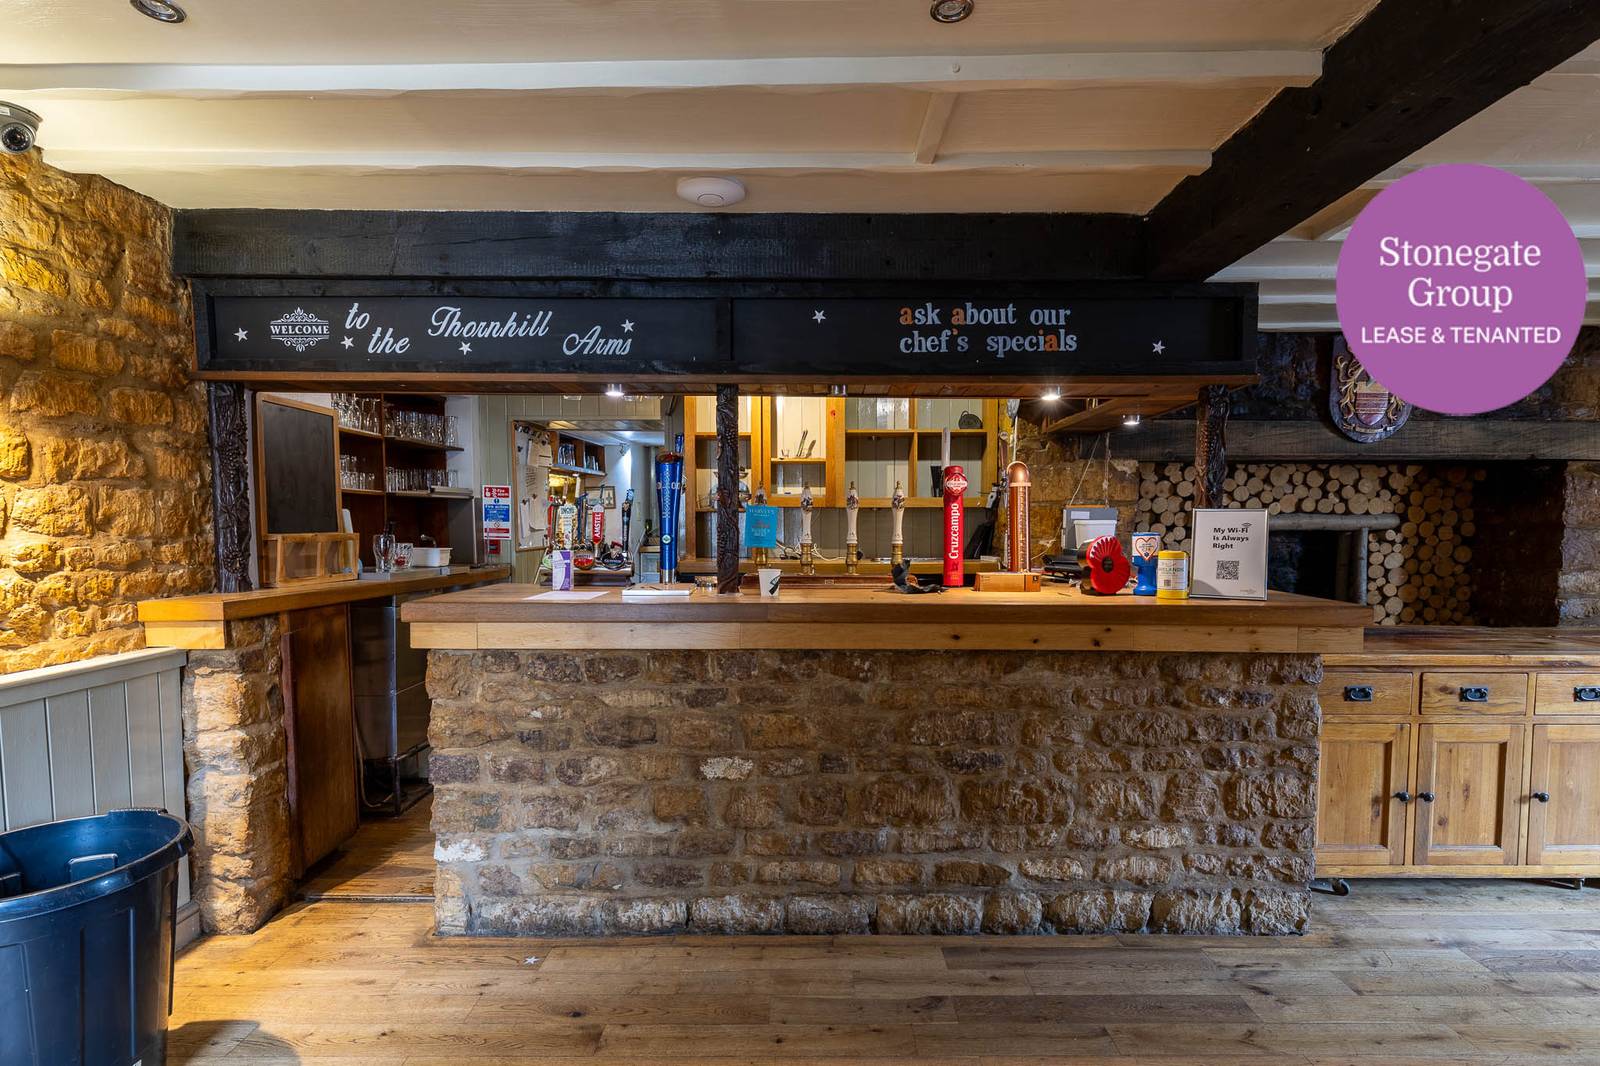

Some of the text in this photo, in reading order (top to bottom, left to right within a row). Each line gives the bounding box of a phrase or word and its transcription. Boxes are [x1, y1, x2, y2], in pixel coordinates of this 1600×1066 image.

[270, 302, 633, 356] WELCOME to the Thornhill Arms
[900, 302, 1071, 326] ask about our
[900, 328, 1078, 358] chef's specials
[594, 512, 602, 538] AMSTEL
[948, 503, 960, 559] Cruzcampo
